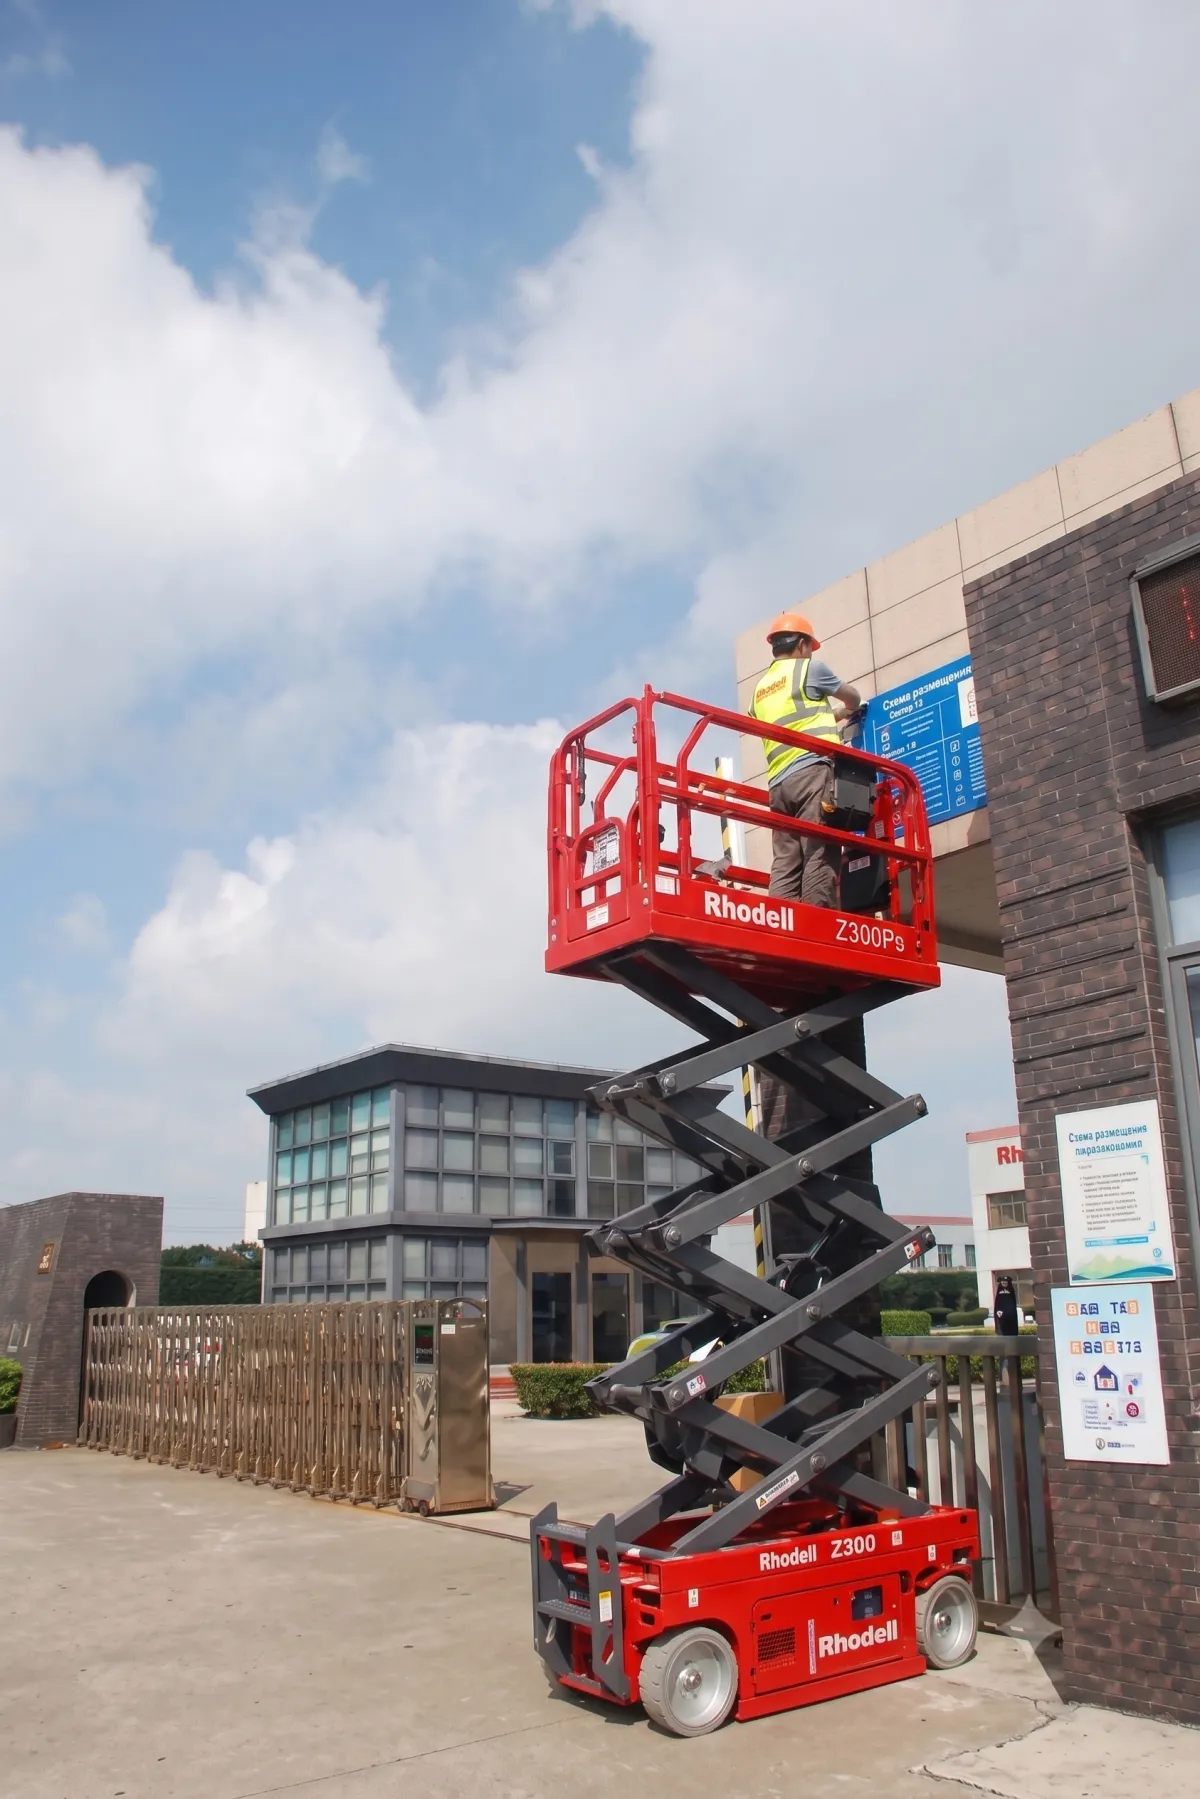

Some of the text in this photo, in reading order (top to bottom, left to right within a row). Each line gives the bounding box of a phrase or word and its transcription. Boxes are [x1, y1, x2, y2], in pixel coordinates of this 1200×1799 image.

[704, 890, 794, 931] Rhodell
[836, 918, 905, 952] Z300Ps
[760, 1544, 817, 1571] Rhodell
[831, 1534, 876, 1559] Z300
[818, 1619, 898, 1659] Rhodell
